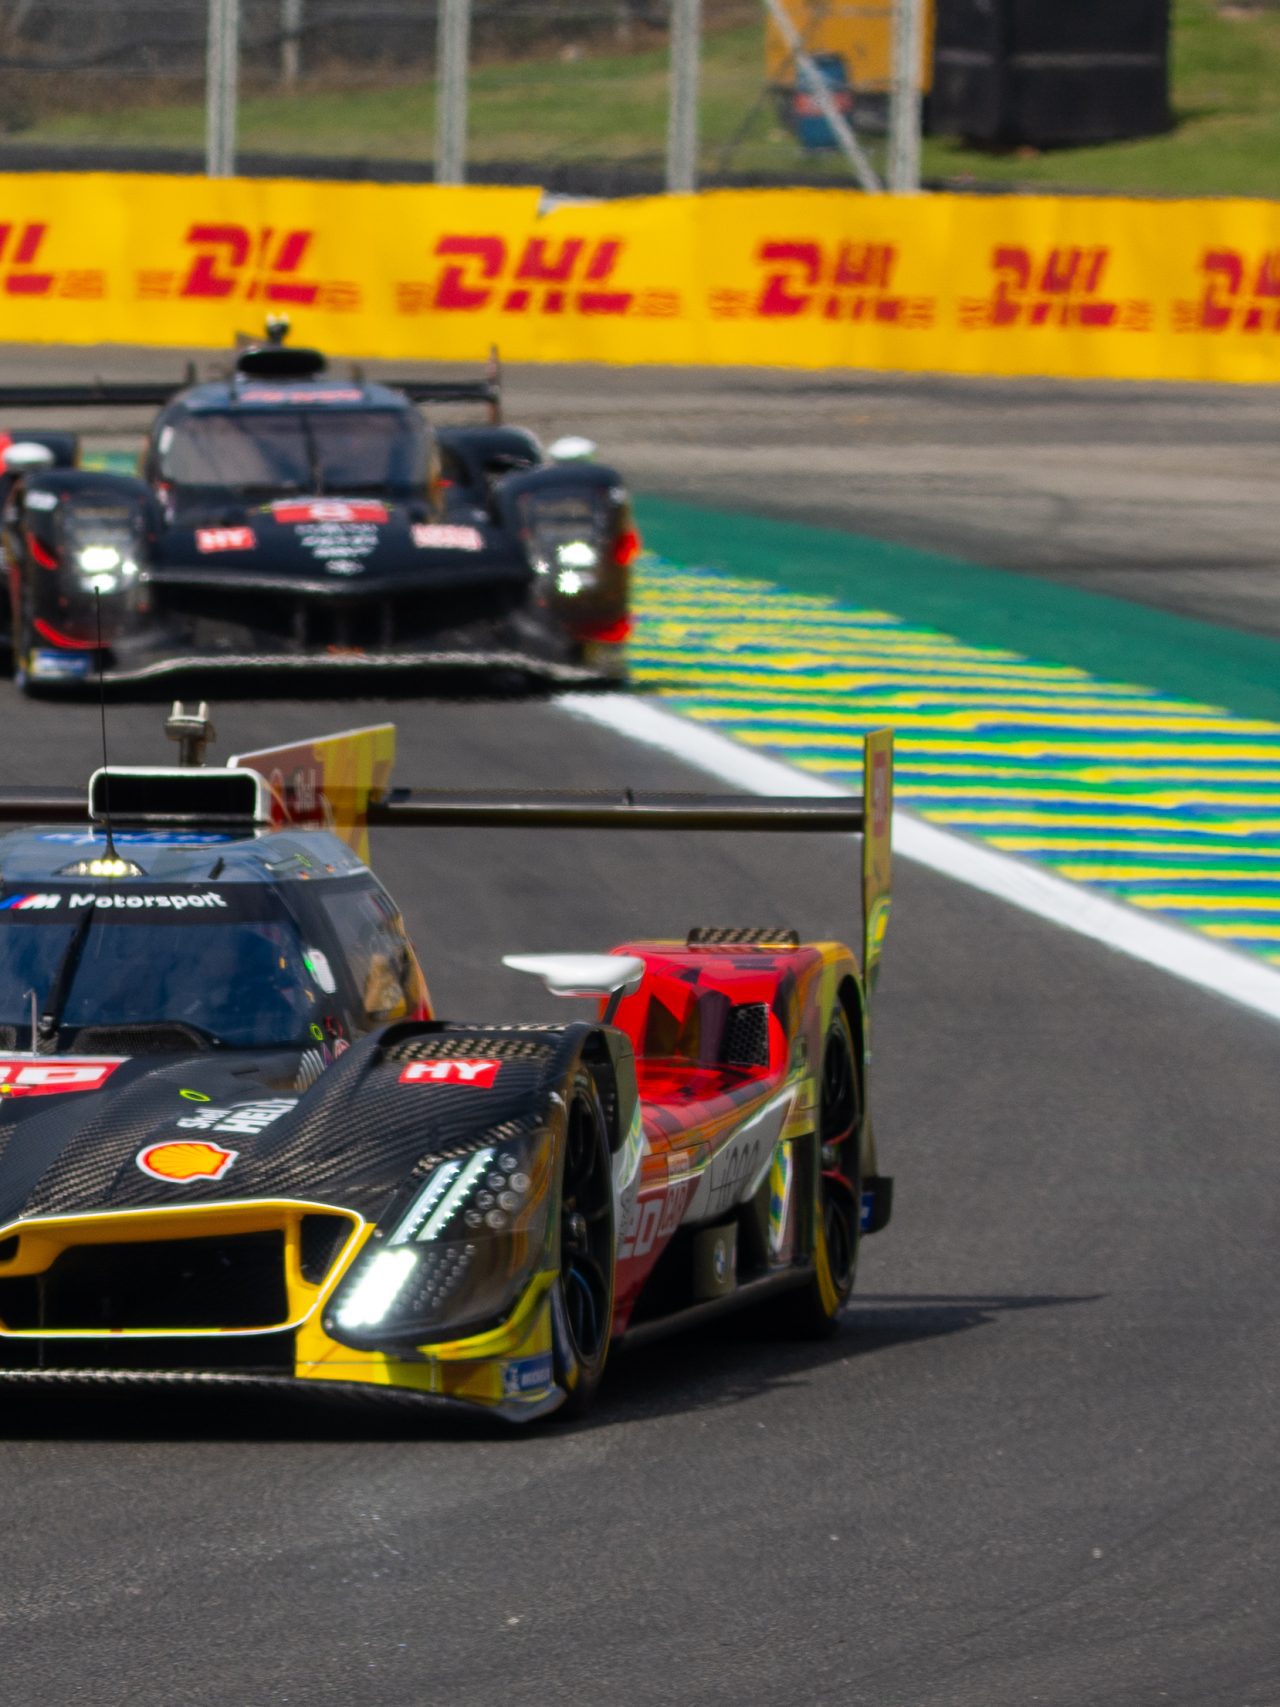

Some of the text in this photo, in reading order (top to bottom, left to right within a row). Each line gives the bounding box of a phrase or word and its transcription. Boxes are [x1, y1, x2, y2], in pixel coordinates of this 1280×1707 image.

[430, 235, 635, 316] DHL
[754, 239, 909, 325] DHL
[985, 245, 1120, 329] DHL
[68, 891, 228, 910] Motorsport
[405, 1061, 496, 1080] HY
